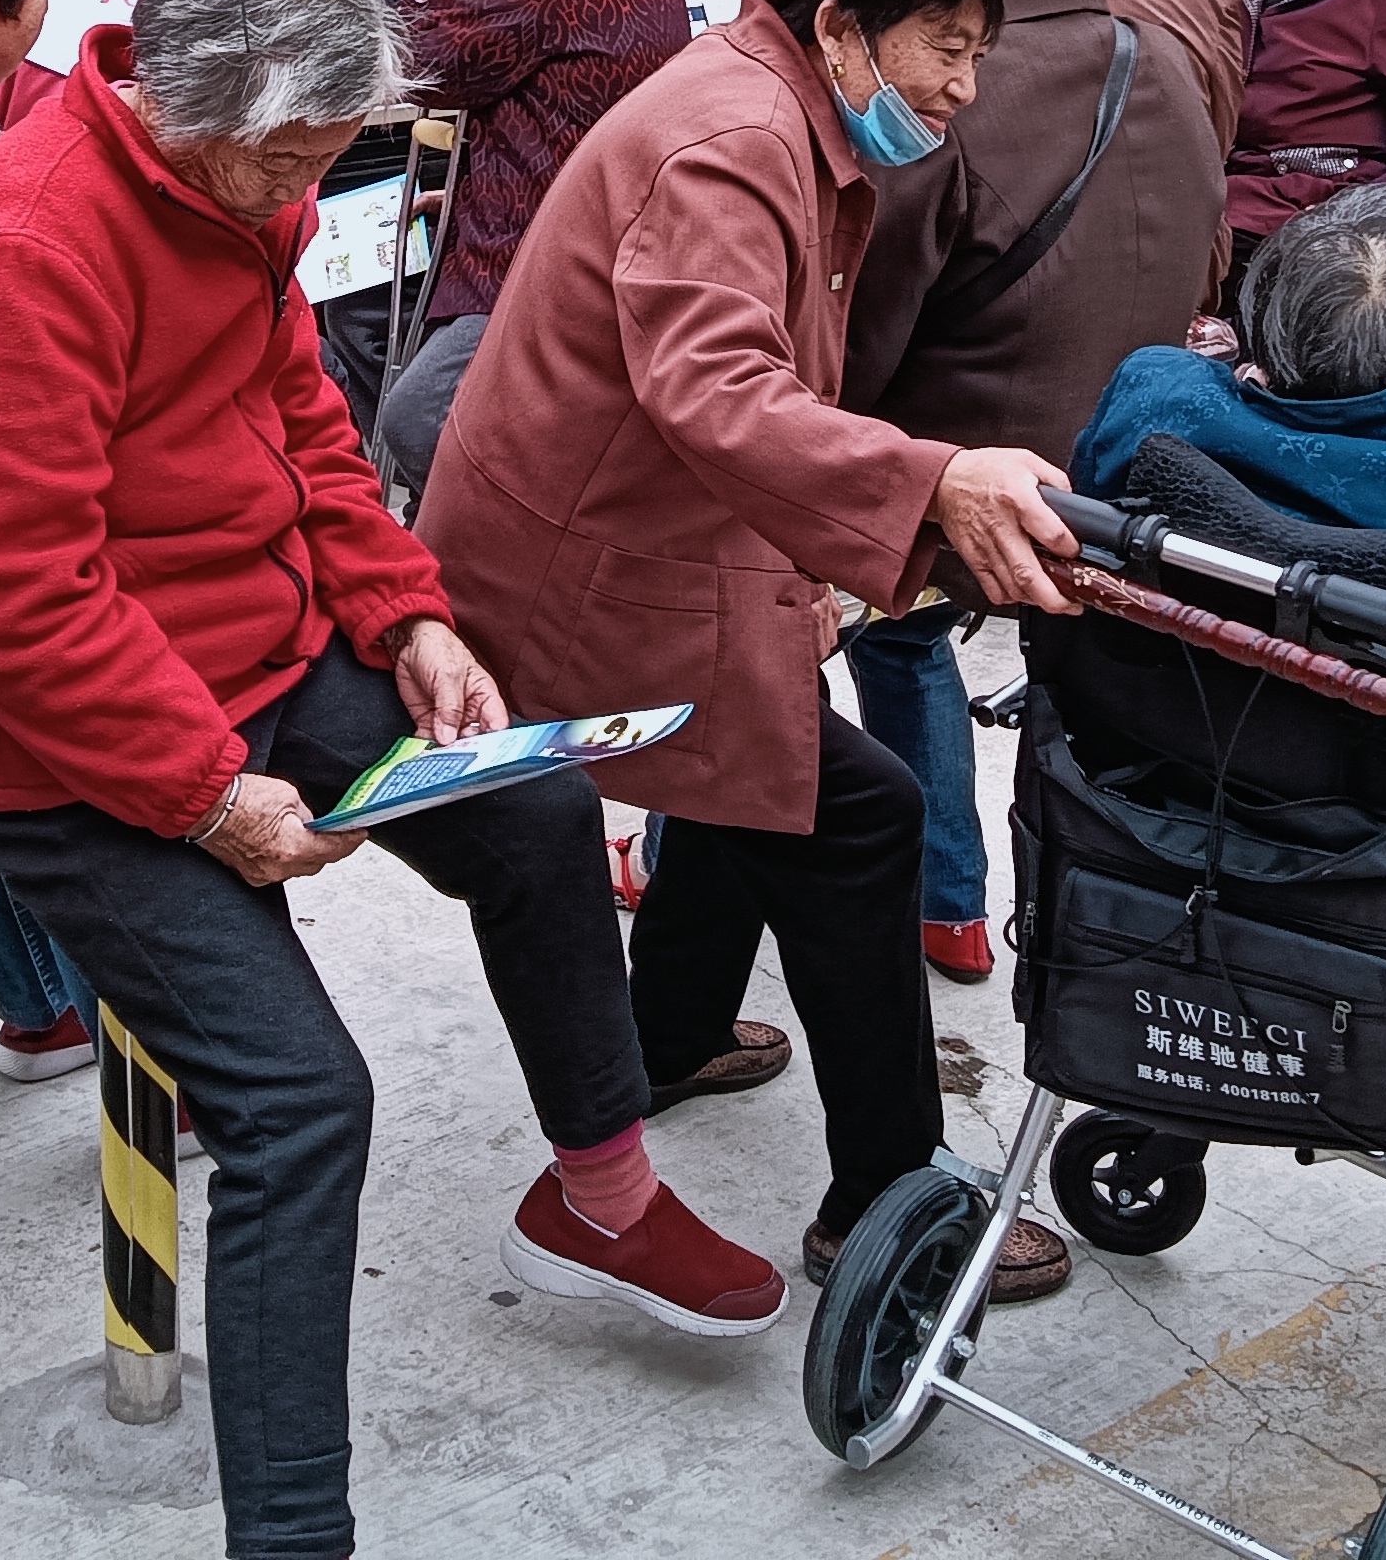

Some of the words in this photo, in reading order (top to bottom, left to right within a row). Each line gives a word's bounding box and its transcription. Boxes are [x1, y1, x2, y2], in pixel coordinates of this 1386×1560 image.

[1146, 1025, 1306, 1078] 斯维驰健康
